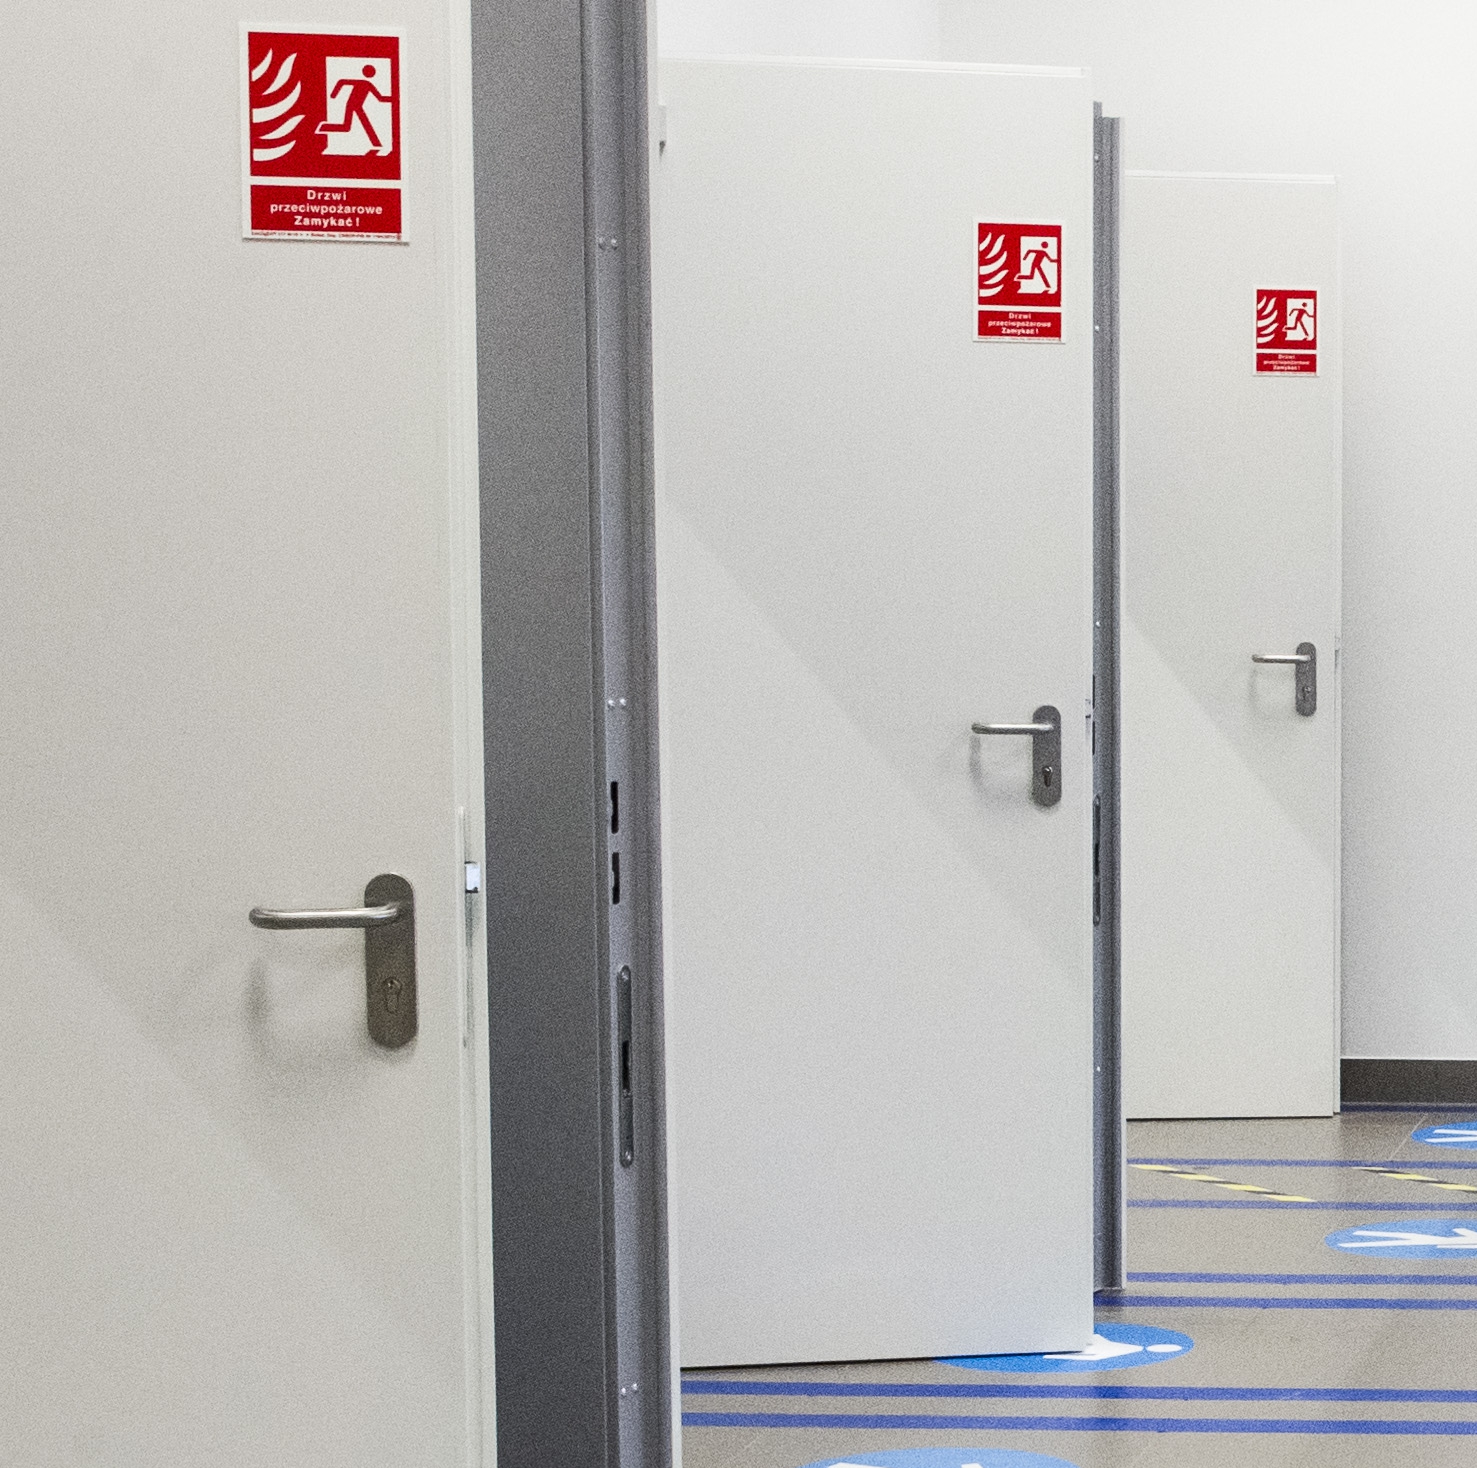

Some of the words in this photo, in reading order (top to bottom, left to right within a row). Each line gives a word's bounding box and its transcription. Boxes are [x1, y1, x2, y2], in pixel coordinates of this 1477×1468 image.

[306, 190, 346, 201] Drzwi
[270, 203, 383, 215] przeciwpożarowe
[294, 216, 353, 228] Zamykać
